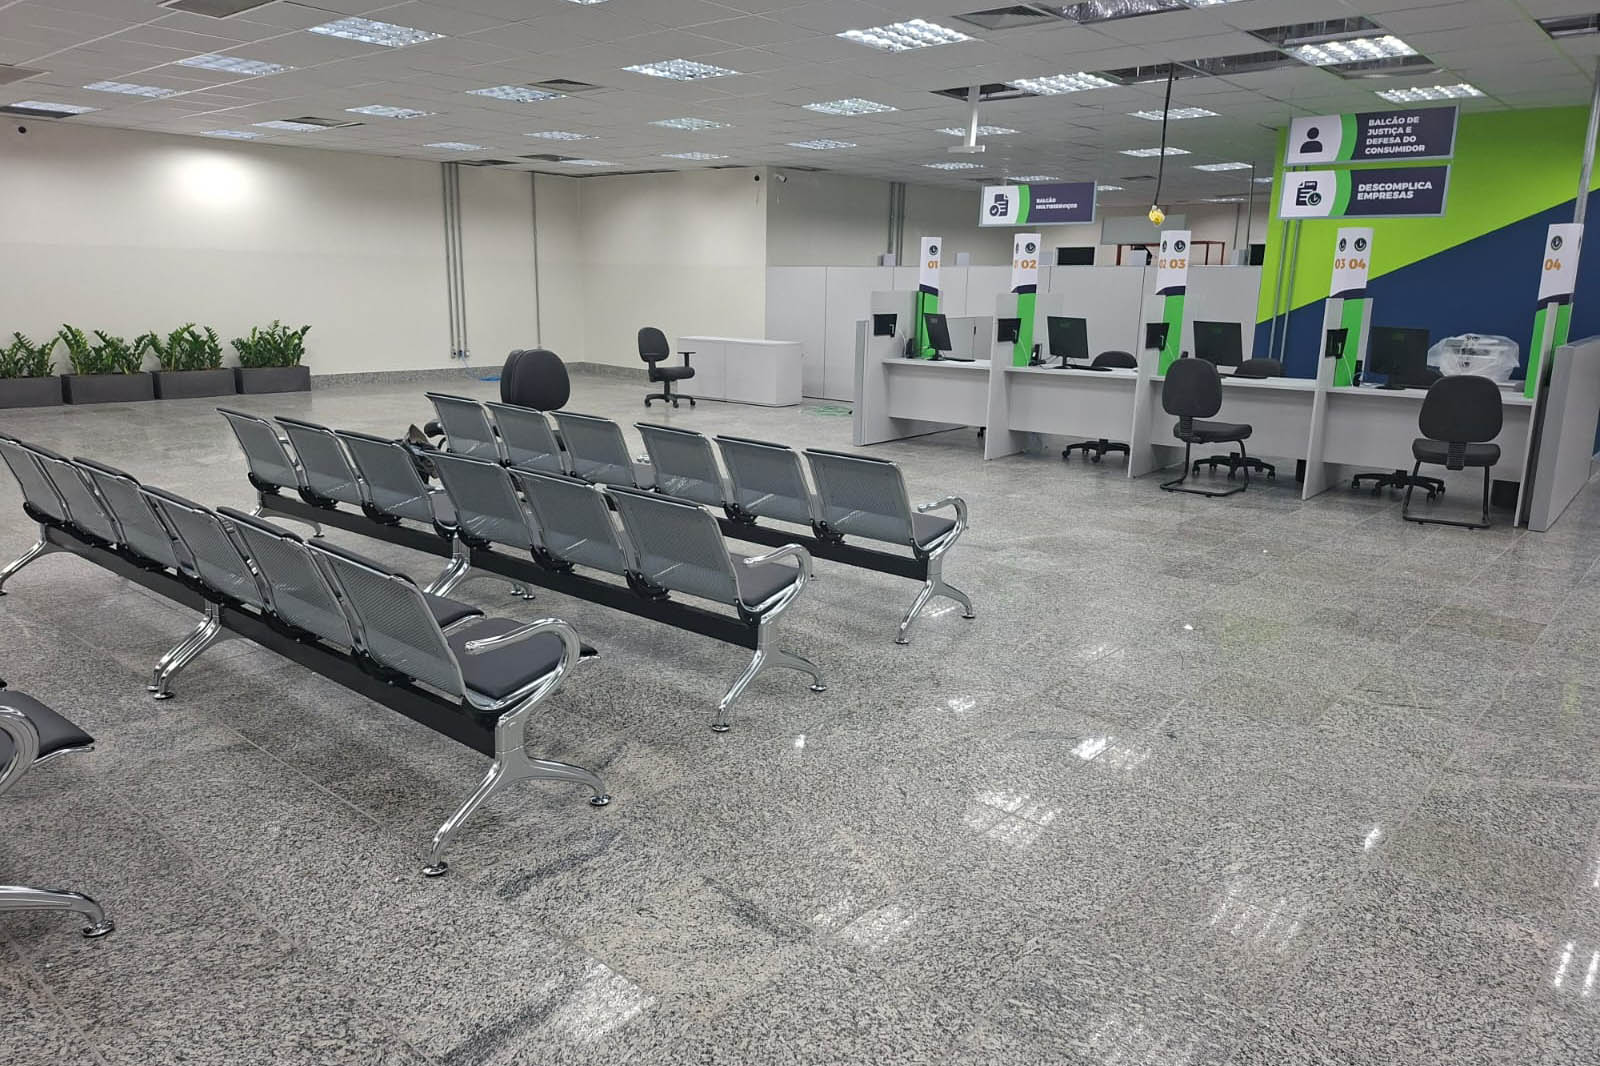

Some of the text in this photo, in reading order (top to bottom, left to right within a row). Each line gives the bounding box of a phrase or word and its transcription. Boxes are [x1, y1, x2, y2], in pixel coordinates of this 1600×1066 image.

[1368, 116, 1420, 126] BALCÃO DE
[1367, 126, 1404, 136] JUSTIÇA
[1366, 135, 1417, 145] DEFESA DO
[1365, 144, 1425, 154] CONSUMIDOR
[1358, 181, 1433, 192] DESCOMPLICA
[1357, 190, 1414, 201] EMPRESAS
[927, 260, 939, 269] 01
[1021, 260, 1038, 269] 02
[1169, 258, 1186, 269] 03
[1335, 258, 1366, 270] 03 04
[1545, 258, 1562, 271] 04
